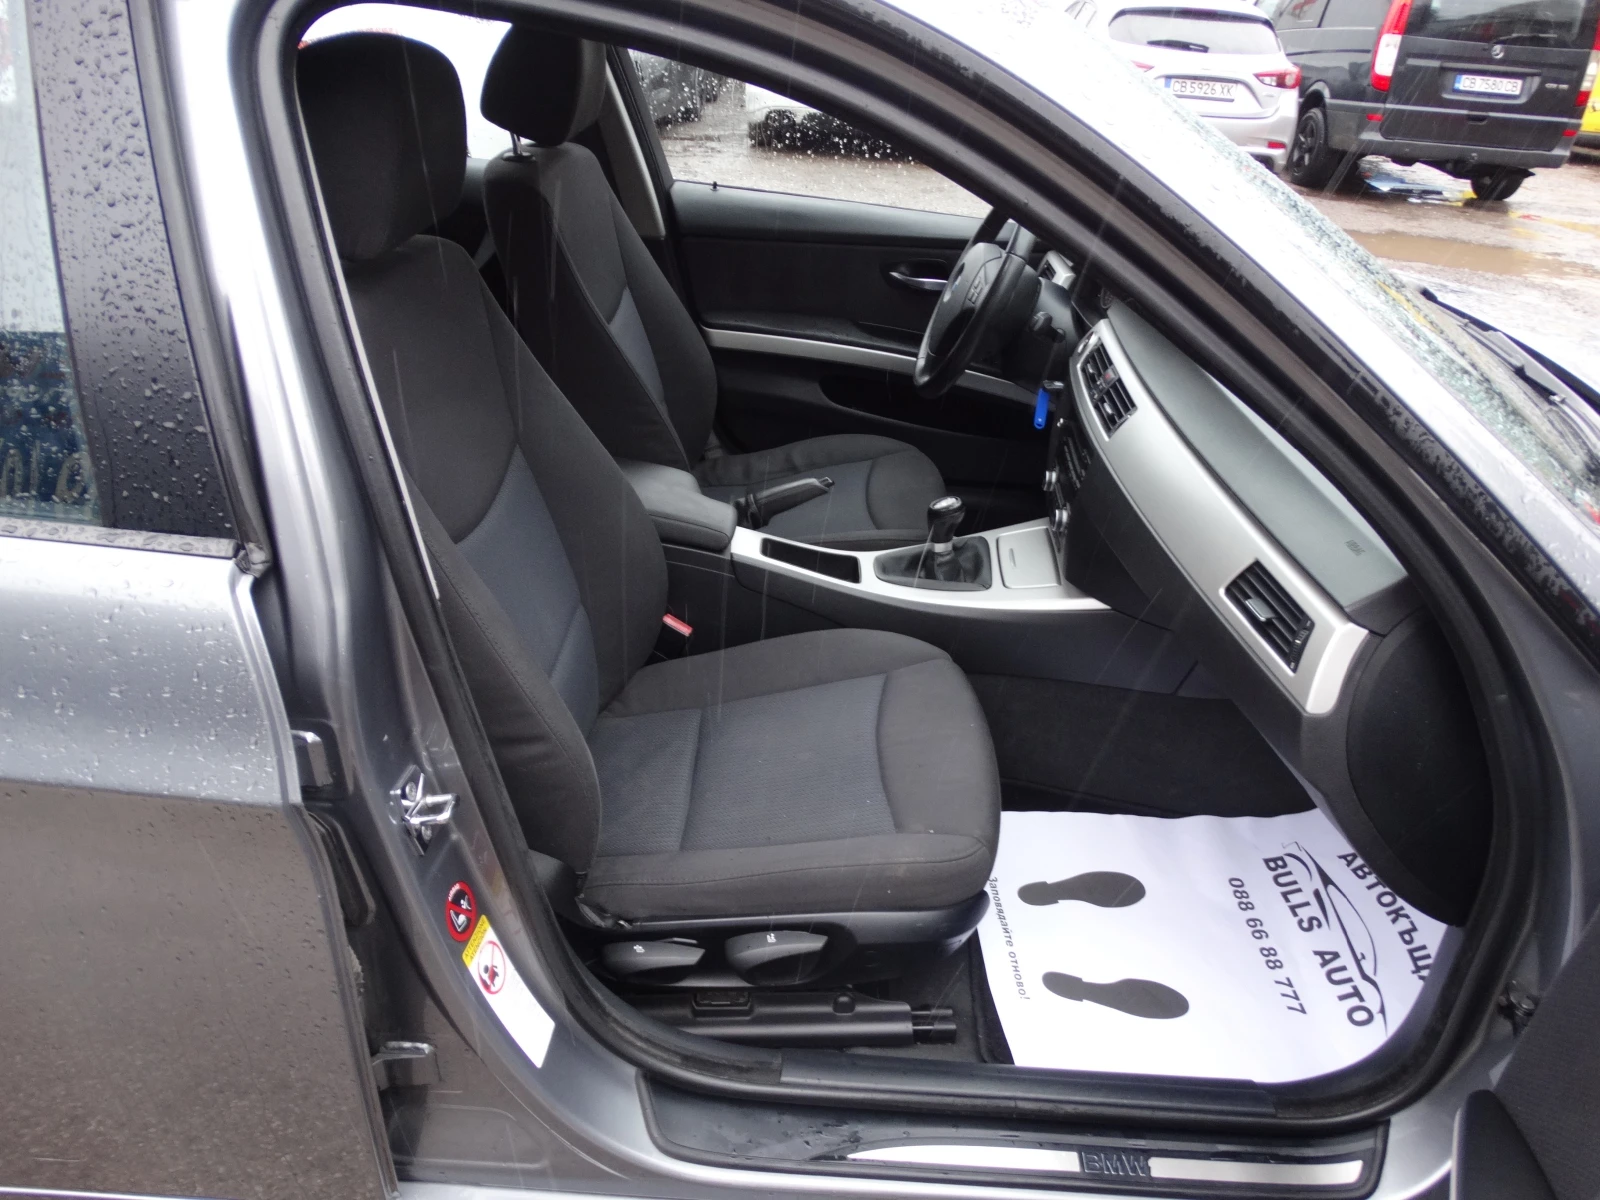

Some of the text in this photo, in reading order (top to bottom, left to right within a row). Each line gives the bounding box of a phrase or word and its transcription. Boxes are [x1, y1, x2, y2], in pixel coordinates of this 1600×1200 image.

[1172, 80, 1235, 97] CB 5926 XK
[1462, 77, 1519, 93] CB 7580 CB
[989, 876, 1031, 1000] Заповядайте отново!
[1228, 877, 1307, 1016] 088 66 88 777
[1262, 855, 1374, 1027] BULLS AUTO
[1337, 852, 1431, 981] АВТОКЪЩ
[1081, 1150, 1147, 1177] BMW
